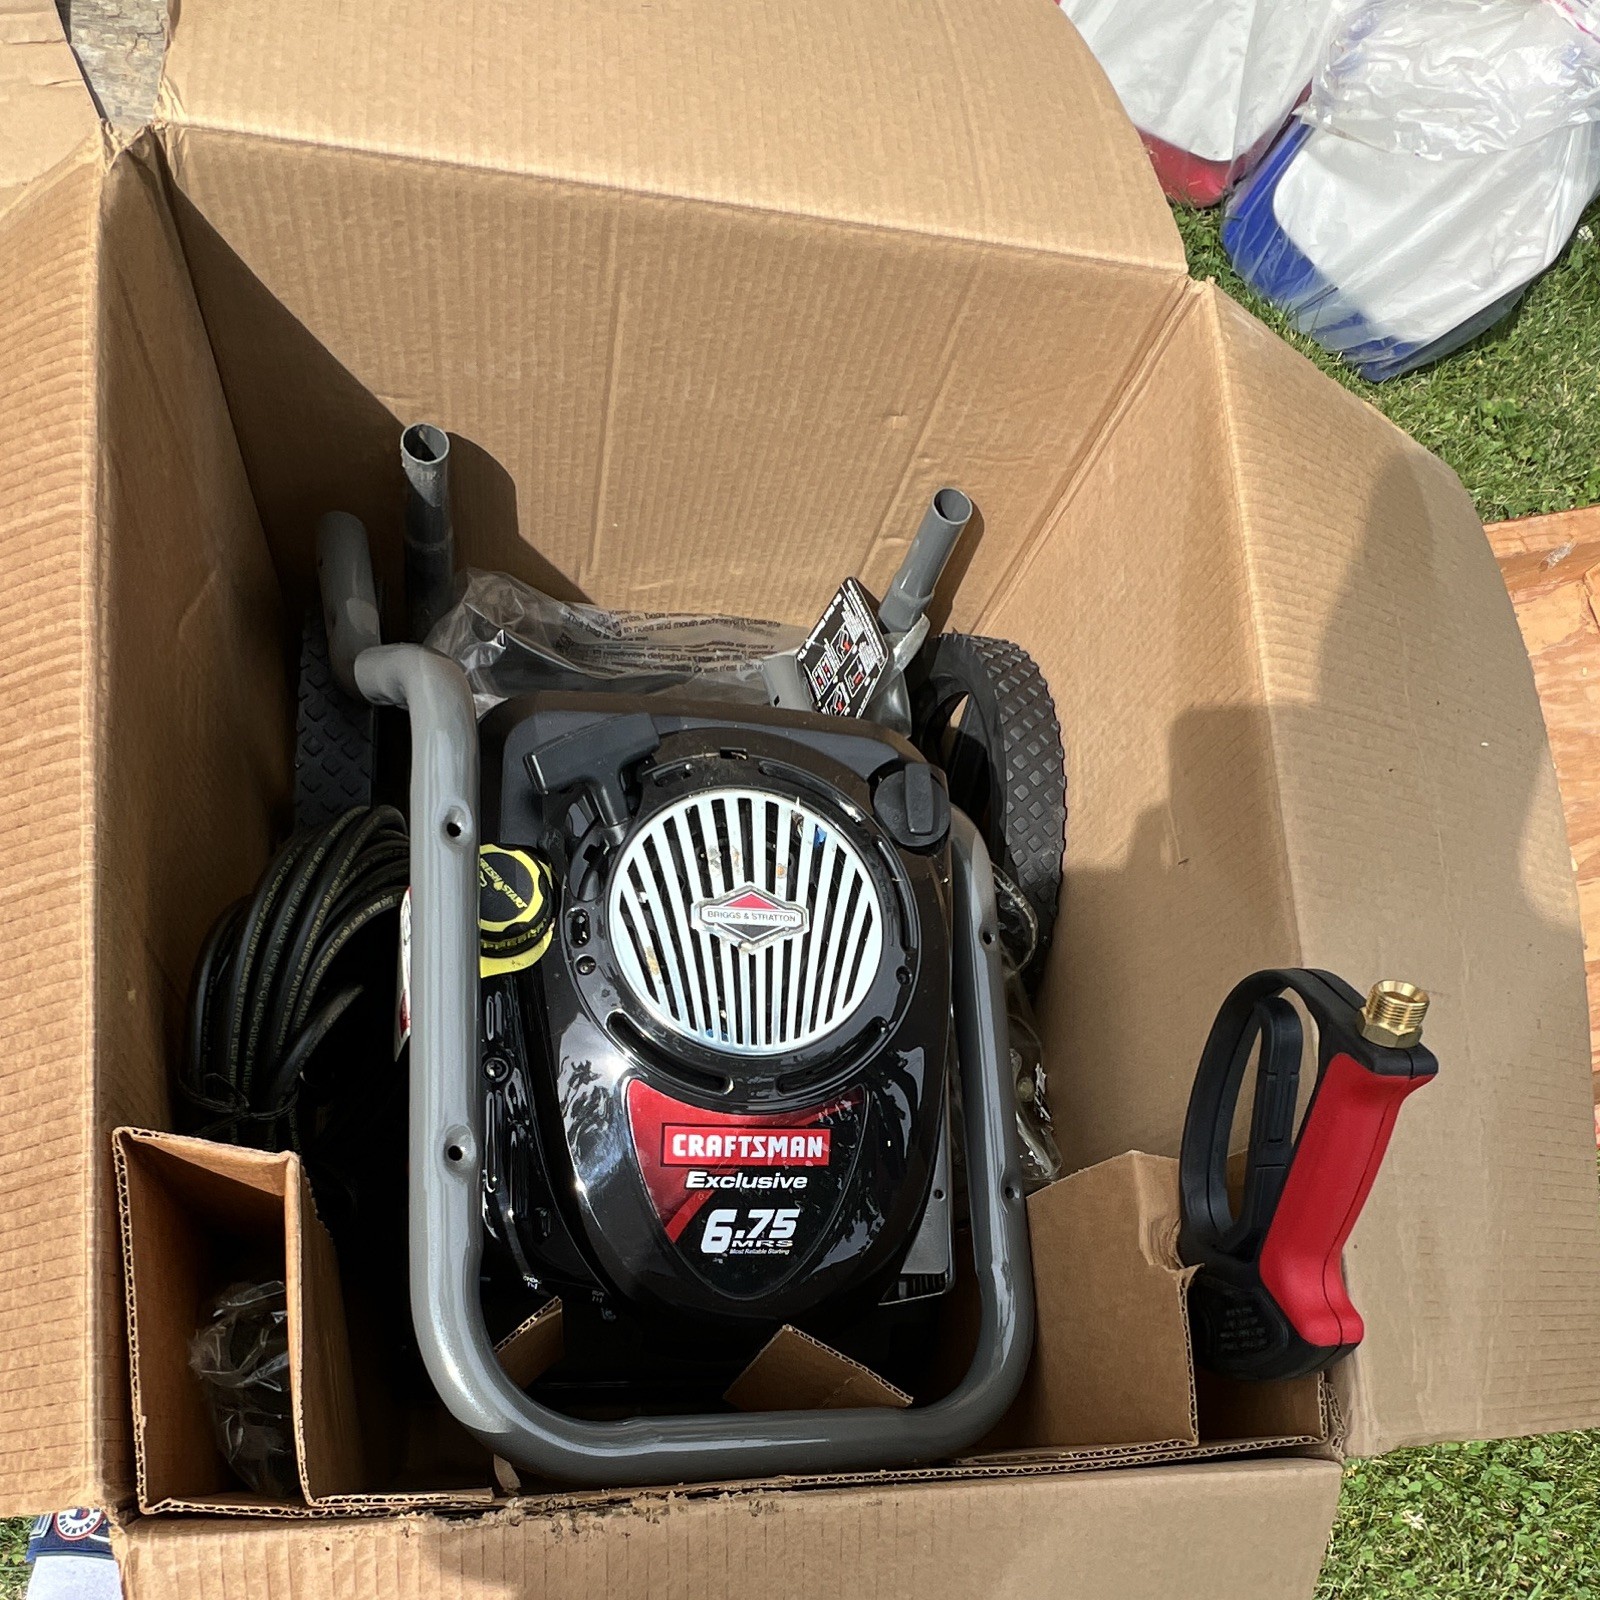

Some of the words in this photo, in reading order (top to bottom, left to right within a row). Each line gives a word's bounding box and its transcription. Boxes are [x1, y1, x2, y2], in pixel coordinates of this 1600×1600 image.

[656, 622, 671, 630] and
[673, 619, 699, 628] mouth
[503, 884, 528, 909] START
[708, 911, 741, 920] BRIGGS
[751, 913, 796, 922] STRATTON
[248, 922, 263, 954] PATENT
[276, 925, 288, 945] MAX
[286, 975, 302, 1009] PATENT
[672, 1134, 823, 1158] CRAFTSMAN
[686, 1171, 808, 1189] Exclusive
[700, 1208, 801, 1255] 6.75
[731, 1239, 793, 1248] MRS
[768, 1248, 790, 1256] Starting
